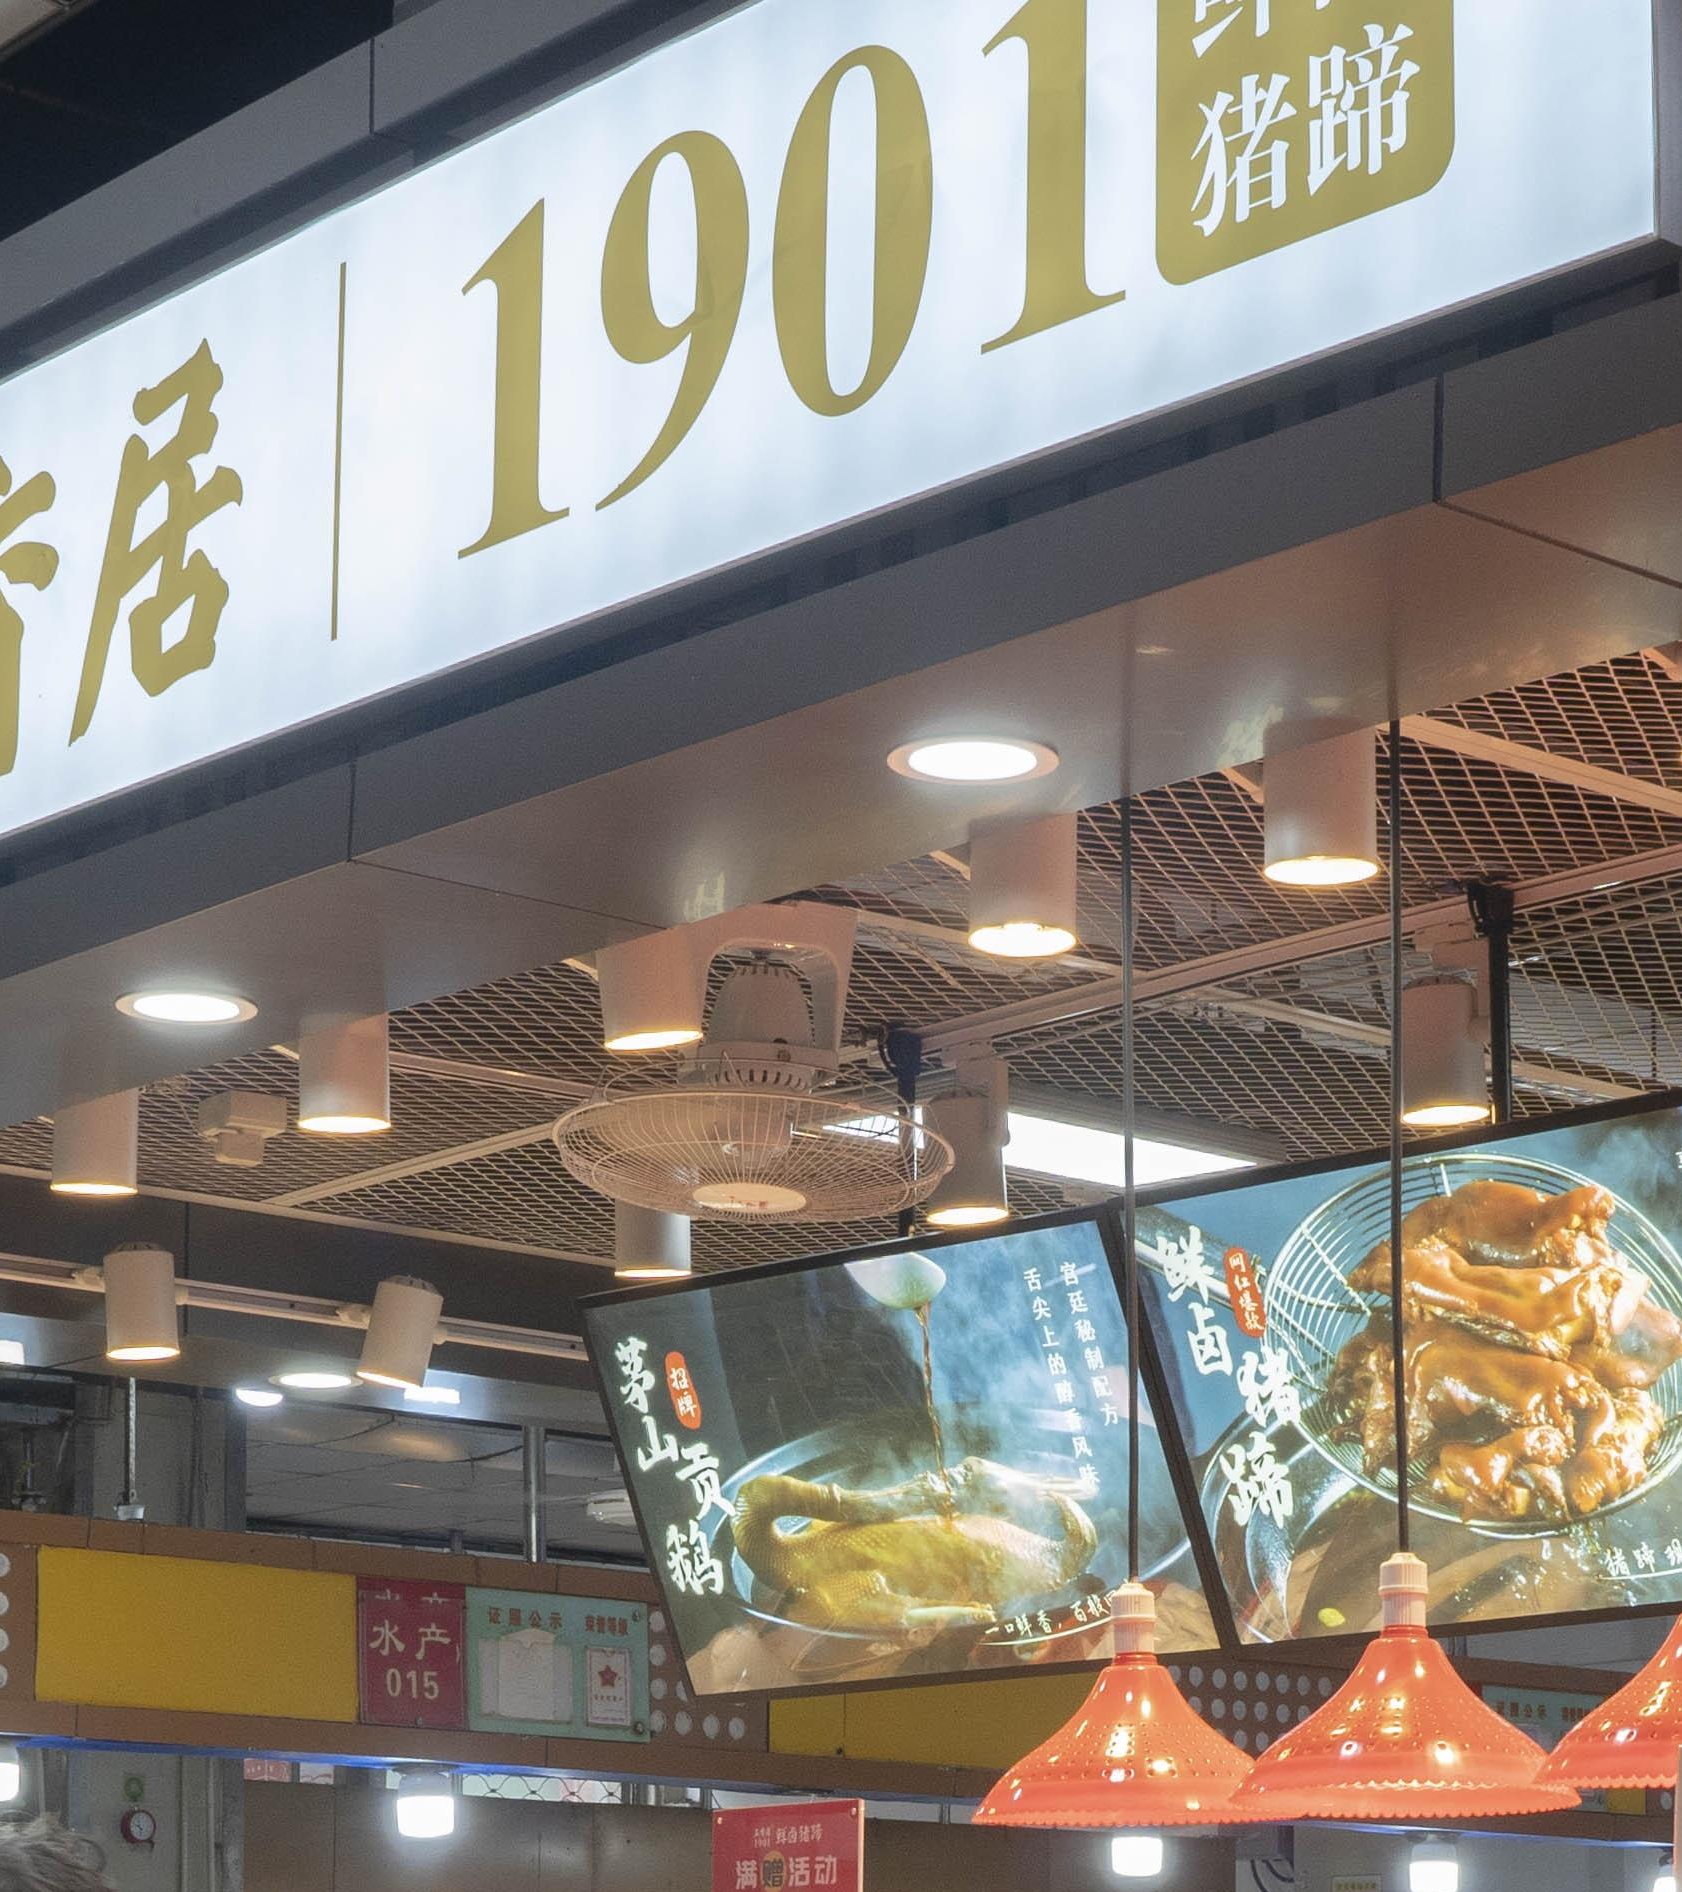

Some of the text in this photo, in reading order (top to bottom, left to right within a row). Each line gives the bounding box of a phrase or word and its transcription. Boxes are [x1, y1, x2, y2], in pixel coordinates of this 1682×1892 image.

[1191, 24, 1420, 237] 猪蹄
[457, 0, 1127, 560] 1901
[669, 1367, 698, 1418] 招牌
[1023, 1267, 1101, 1488] 舌尖上的醇香风味
[1059, 1260, 1120, 1427] 宫廷秘制配方
[1156, 1224, 1302, 1529] 鲜卤猪蹄
[615, 1335, 737, 1596] 茅山贡鹅
[368, 1619, 452, 1661] 水产
[385, 1667, 440, 1701] 015
[487, 1606, 563, 1630] 证照公示
[734, 1854, 838, 1891] 满赠活动
